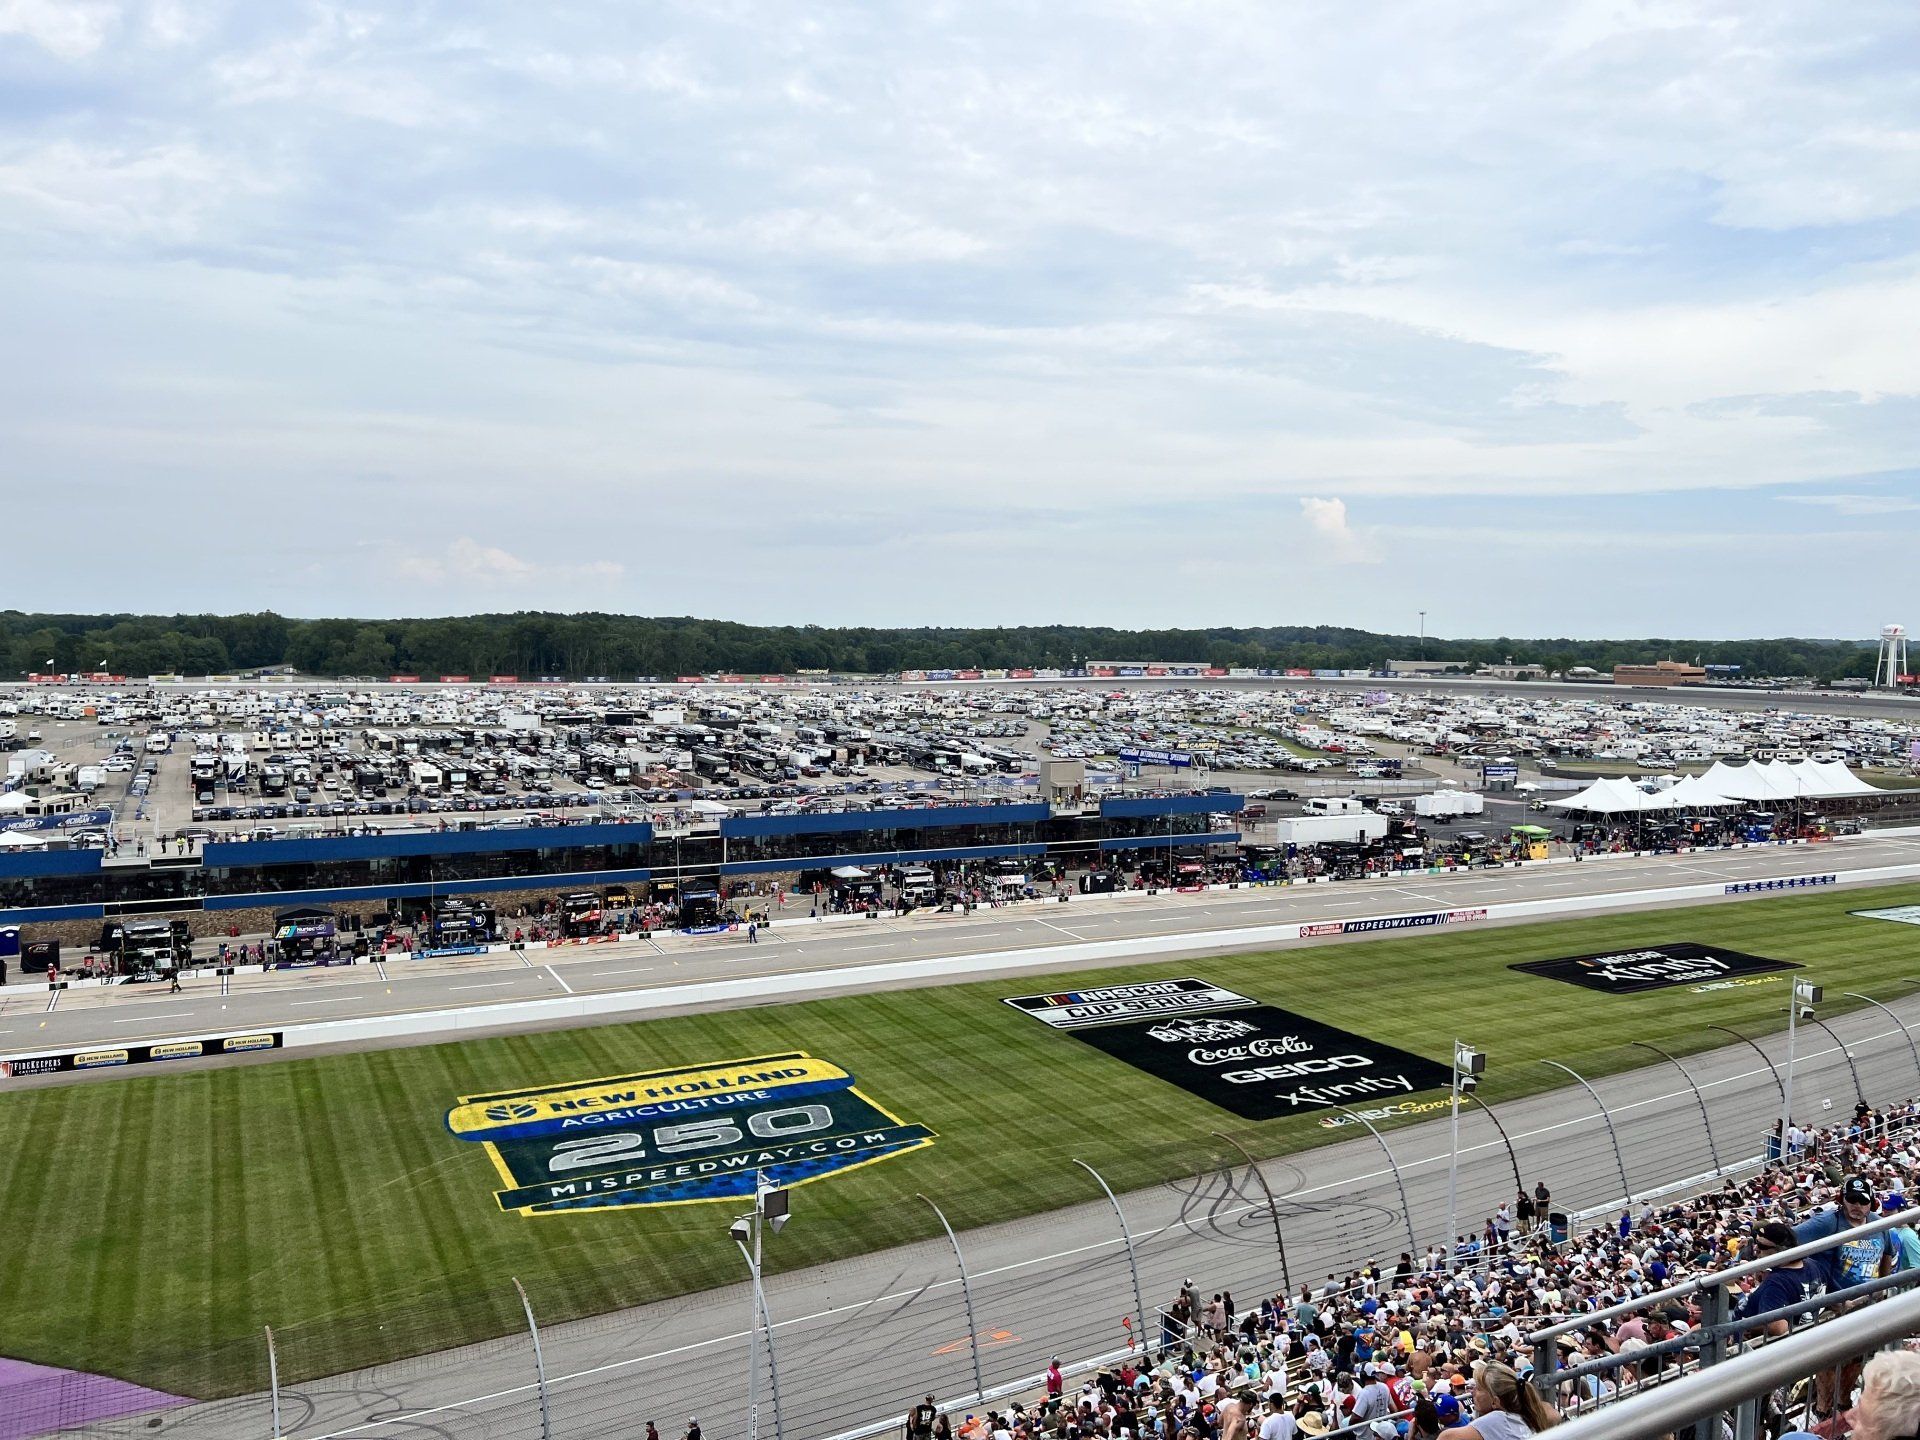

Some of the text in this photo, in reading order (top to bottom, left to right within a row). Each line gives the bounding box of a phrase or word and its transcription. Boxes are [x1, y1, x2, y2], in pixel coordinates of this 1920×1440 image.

[1347, 917, 1433, 932] MISPEEDWAY.com
[1586, 956, 1731, 981] xfinity
[1594, 950, 1668, 965] NASCAR
[1064, 992, 1216, 1018] CUP SERIES
[1077, 982, 1186, 1003] NASCAR
[1146, 1018, 1261, 1043] BUSCH
[1187, 1035, 1314, 1066] Coca-Cola
[14, 1059, 61, 1071] FIREKEEPERS
[1220, 1054, 1375, 1084] GEICO
[550, 1068, 808, 1112] NEW HOLLAND
[1274, 1074, 1414, 1106] xfinity
[561, 1090, 772, 1128] AGRICULTURE
[549, 1104, 834, 1172] 250
[550, 1132, 887, 1197] MISPEEDWAY.COM
